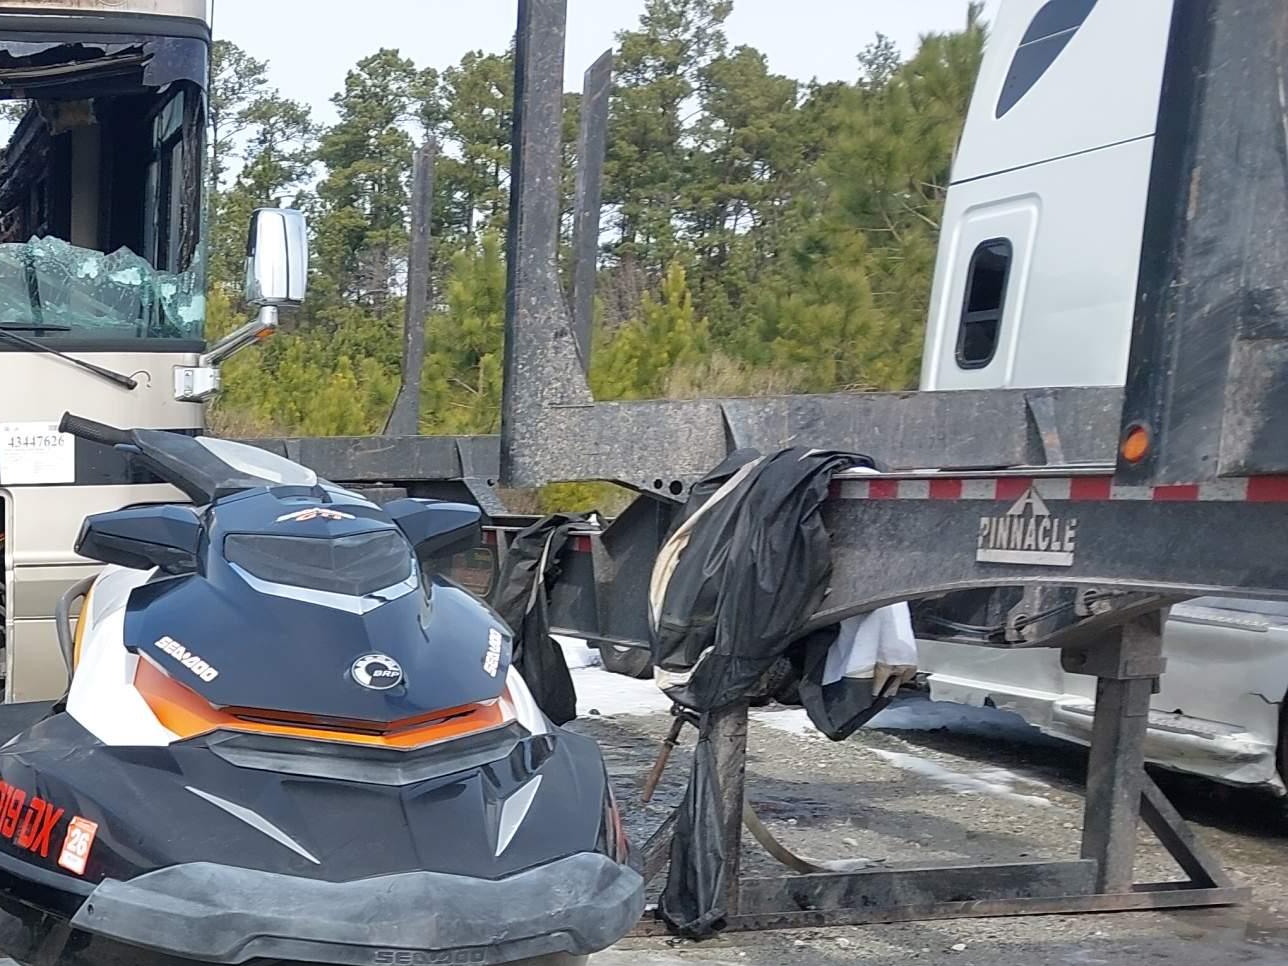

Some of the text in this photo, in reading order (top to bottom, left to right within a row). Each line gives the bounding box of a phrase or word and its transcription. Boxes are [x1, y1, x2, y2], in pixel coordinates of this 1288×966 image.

[977, 516, 1078, 552] PINNACLE
[372, 669, 402, 679] BRP
[17, 795, 65, 858] DX
[66, 827, 91, 856] 26
